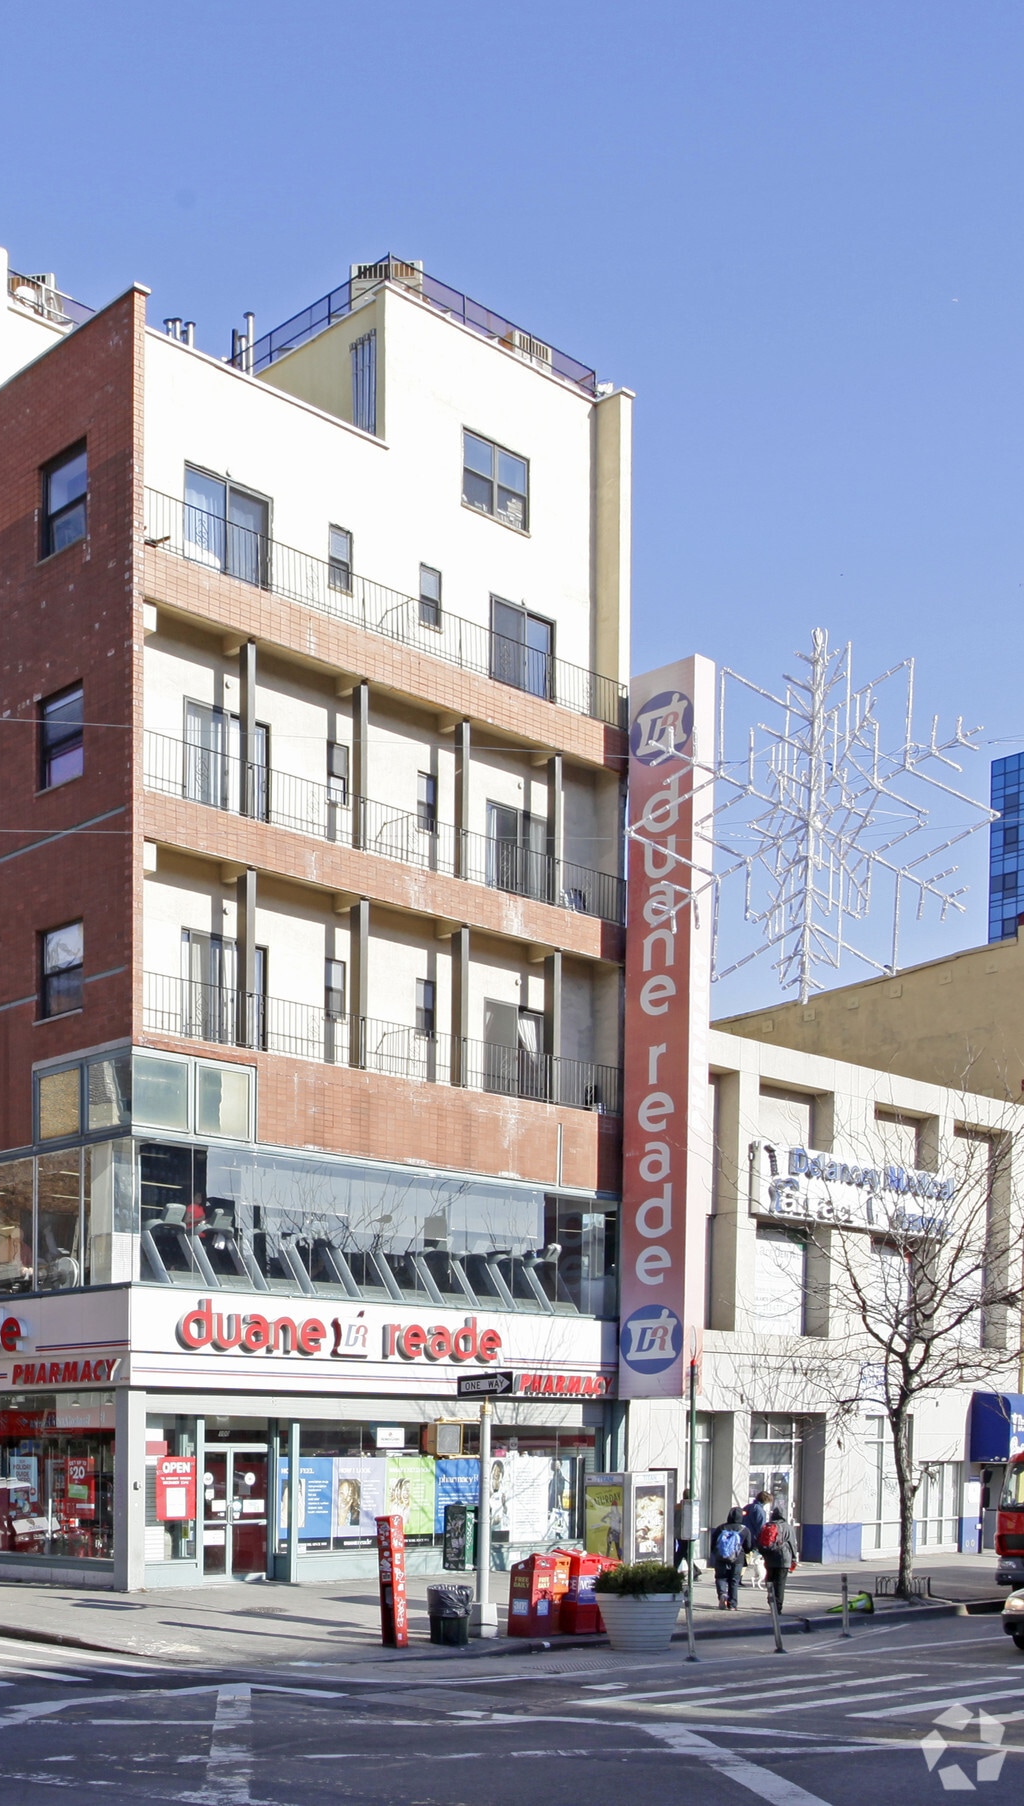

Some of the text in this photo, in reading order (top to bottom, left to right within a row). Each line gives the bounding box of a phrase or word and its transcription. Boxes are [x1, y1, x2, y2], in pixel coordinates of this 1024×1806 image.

[640, 782, 679, 1016] duane
[635, 1043, 675, 1286] reade
[177, 1299, 327, 1356] duane
[382, 1317, 502, 1363] reade
[11, 1358, 122, 1385] PHARMACY
[464, 1378, 505, 1392] ONE WAY
[516, 1373, 614, 1398] PHARMACY
[69, 1465, 85, 1479] $20
[162, 1461, 192, 1474] OPEN
